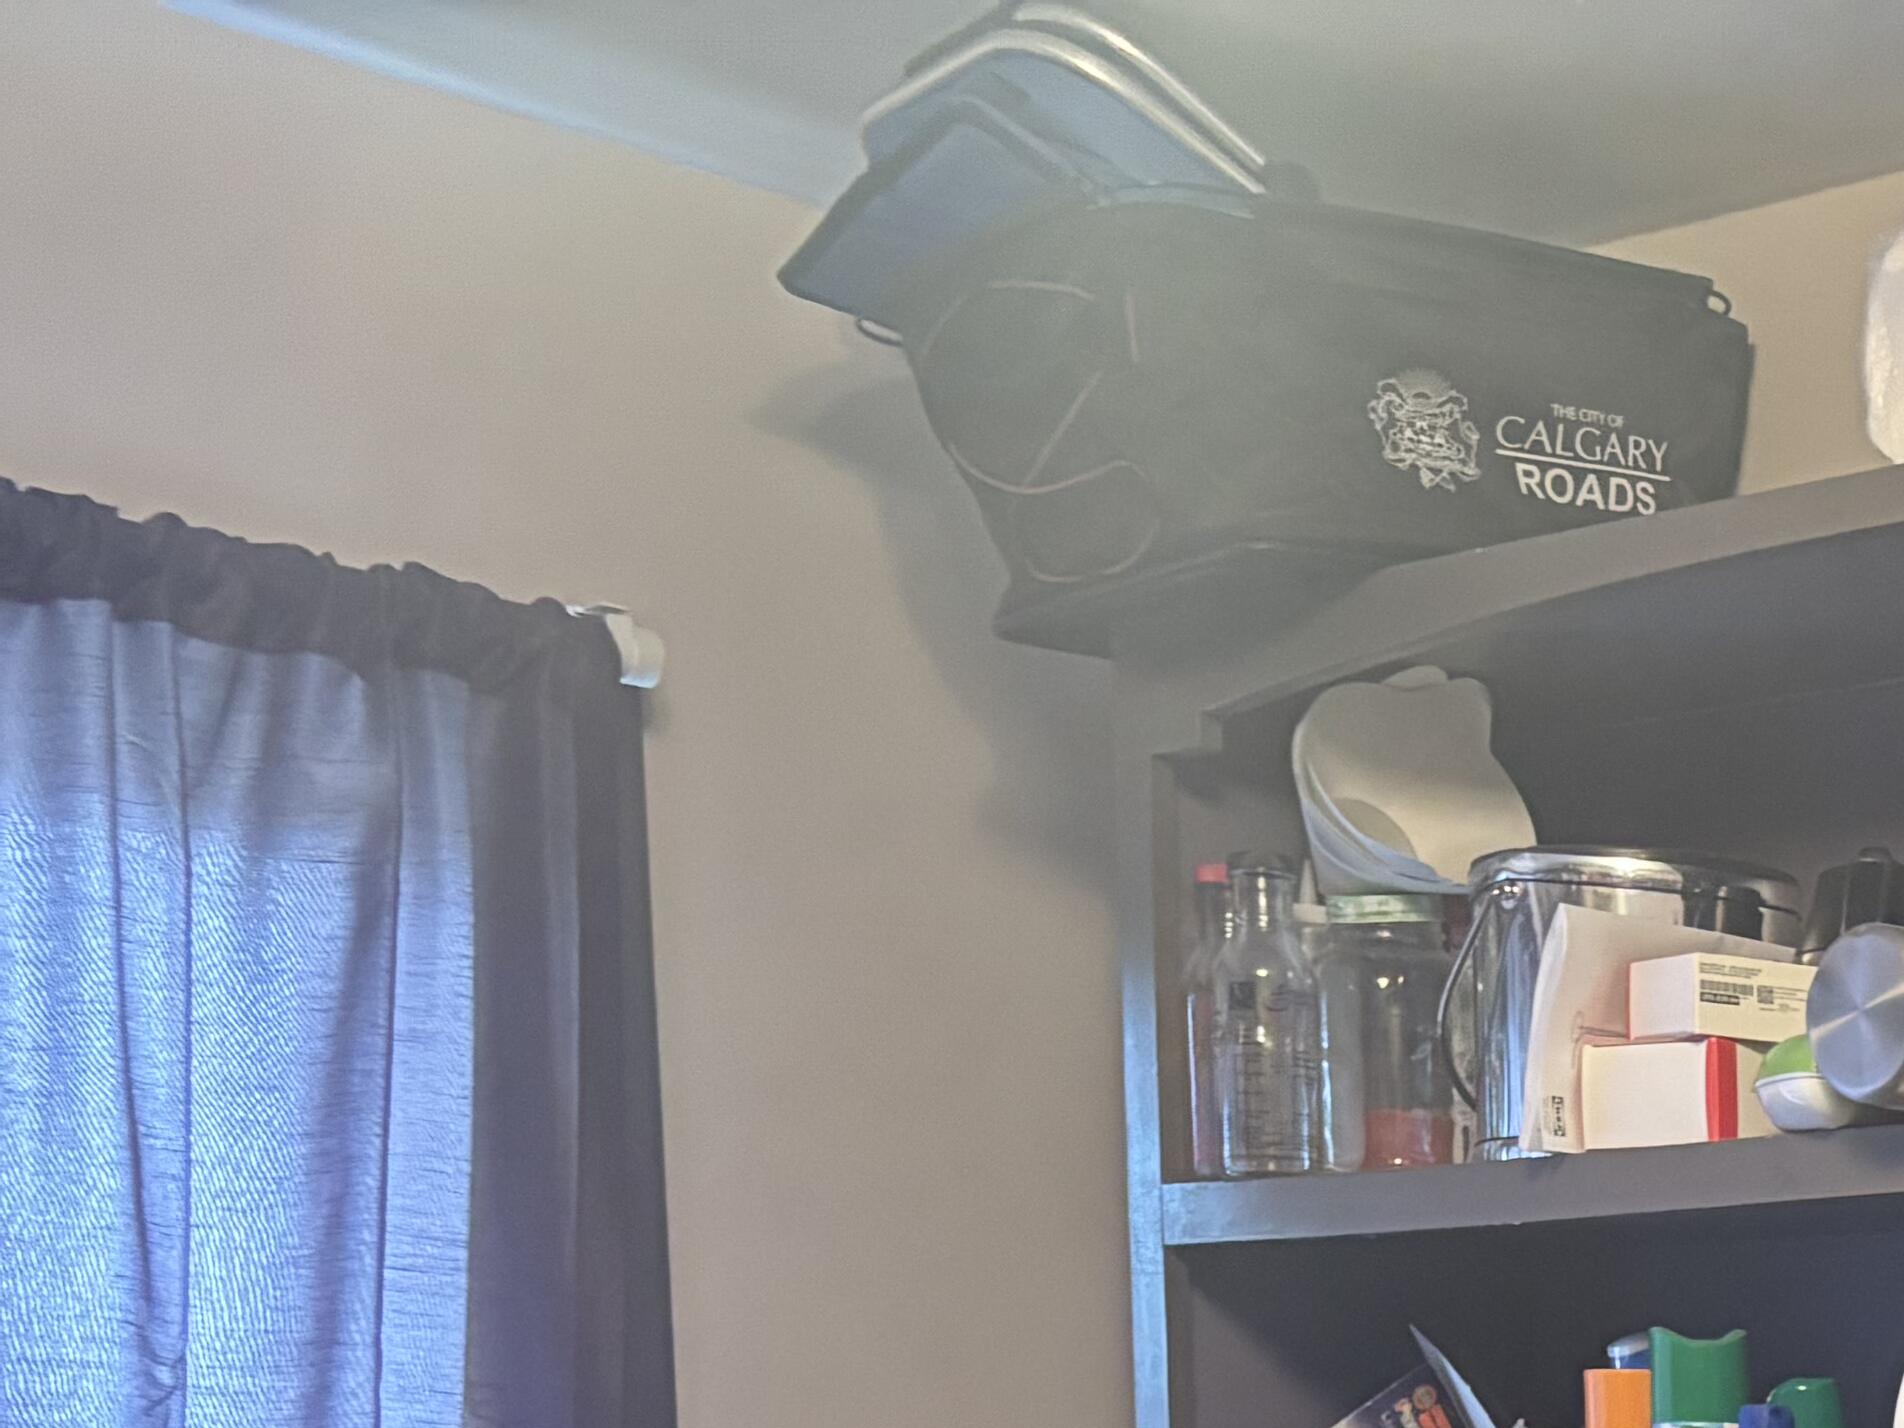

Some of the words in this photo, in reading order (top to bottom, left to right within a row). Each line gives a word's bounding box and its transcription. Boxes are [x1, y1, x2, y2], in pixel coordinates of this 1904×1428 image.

[1550, 403, 1577, 421] THE
[1578, 409, 1605, 424] CITY
[1606, 412, 1626, 429] OF
[1496, 416, 1668, 472] CALGARY
[1515, 462, 1656, 515] ROADS
